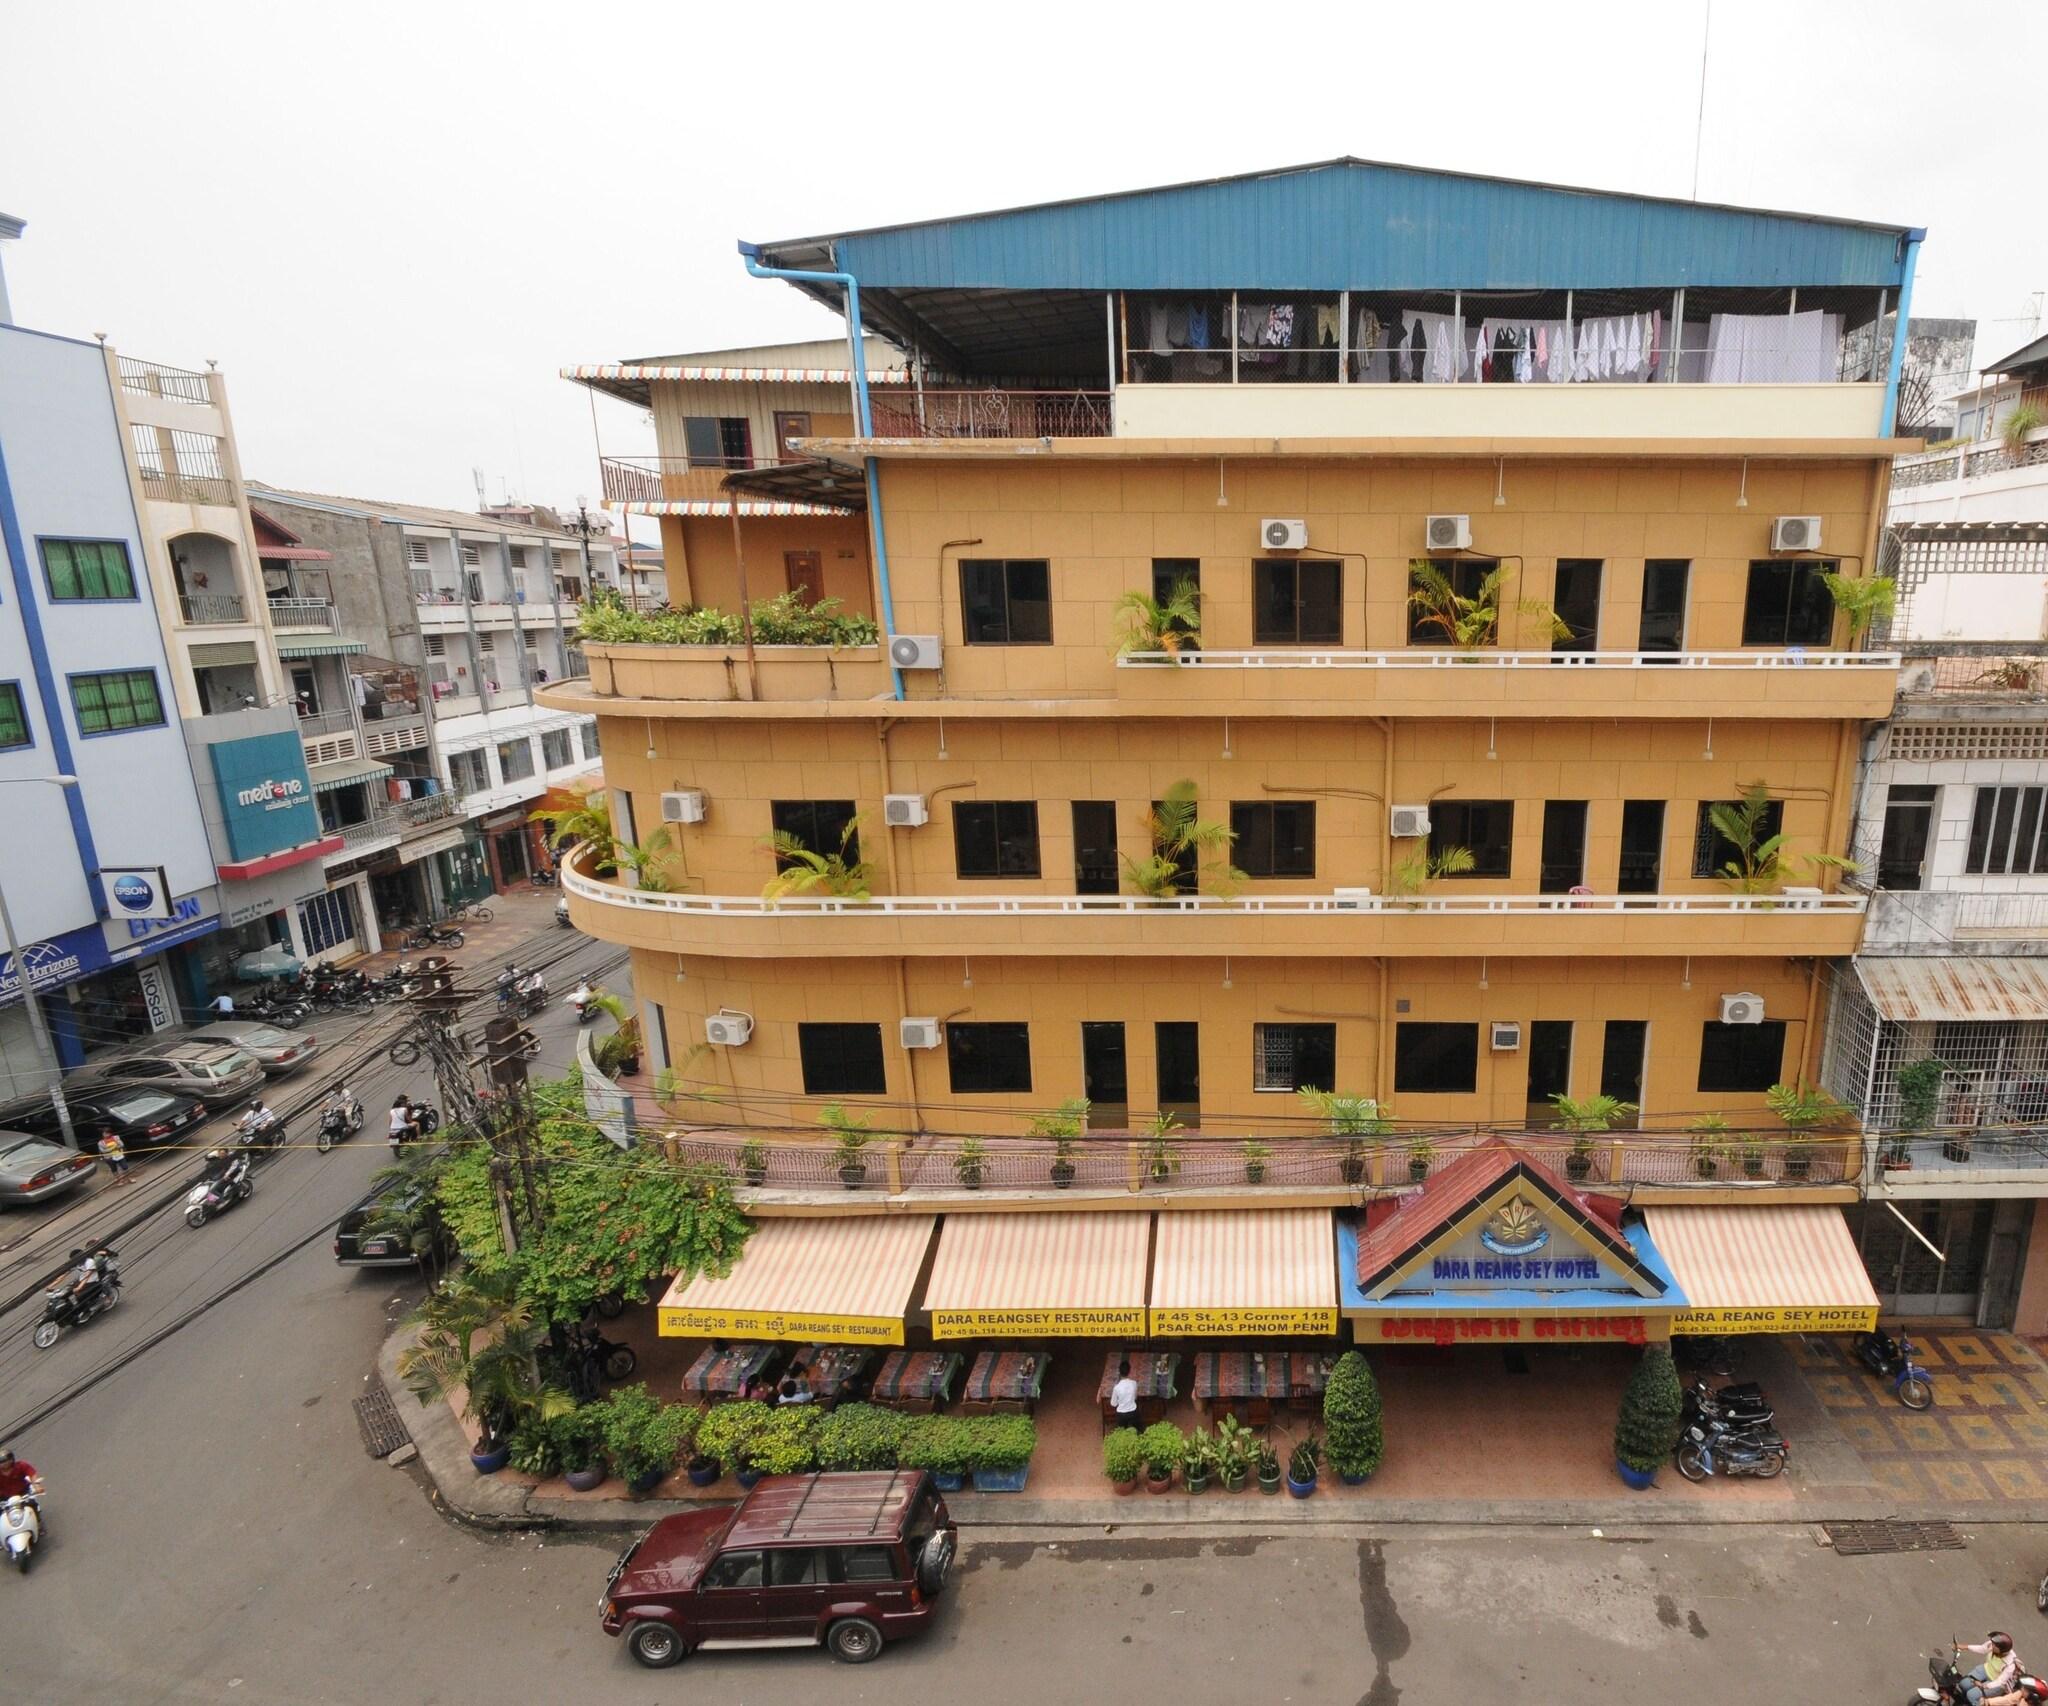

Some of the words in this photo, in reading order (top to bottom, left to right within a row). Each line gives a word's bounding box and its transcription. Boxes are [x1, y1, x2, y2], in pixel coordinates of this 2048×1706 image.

[238, 779, 302, 806] metfone
[115, 886, 149, 896] EPSON
[26, 955, 79, 981] Horizons
[141, 972, 166, 1027] EPSON
[1433, 1259, 1470, 1279] DARA
[1474, 1260, 1523, 1279] REANG
[1524, 1260, 1552, 1279] SEY
[1554, 1259, 1600, 1279] HOTEL
[938, 1314, 973, 1325] DARA
[978, 1313, 1050, 1324] REANGSEY
[1055, 1312, 1140, 1323] RESTAURANT
[1157, 1312, 1165, 1320] #
[1171, 1312, 1189, 1320] 45
[1195, 1312, 1215, 1320] St.
[1222, 1312, 1239, 1320] 13
[1244, 1312, 1296, 1320] Corner
[1302, 1312, 1329, 1320] 118
[1674, 1312, 1716, 1322] DARA
[1722, 1311, 1776, 1321] REANG
[1783, 1311, 1812, 1320] SEY
[1818, 1310, 1869, 1320] HOTEL
[789, 1322, 807, 1331] DARA
[808, 1323, 830, 1333] REANG
[832, 1325, 845, 1333] SEY
[848, 1325, 891, 1336] RESTAURANT
[1158, 1323, 1193, 1332] PSAR
[1197, 1323, 1233, 1332] CHAS
[1239, 1323, 1288, 1332] PHNOM
[1293, 1323, 1329, 1332] PENH
